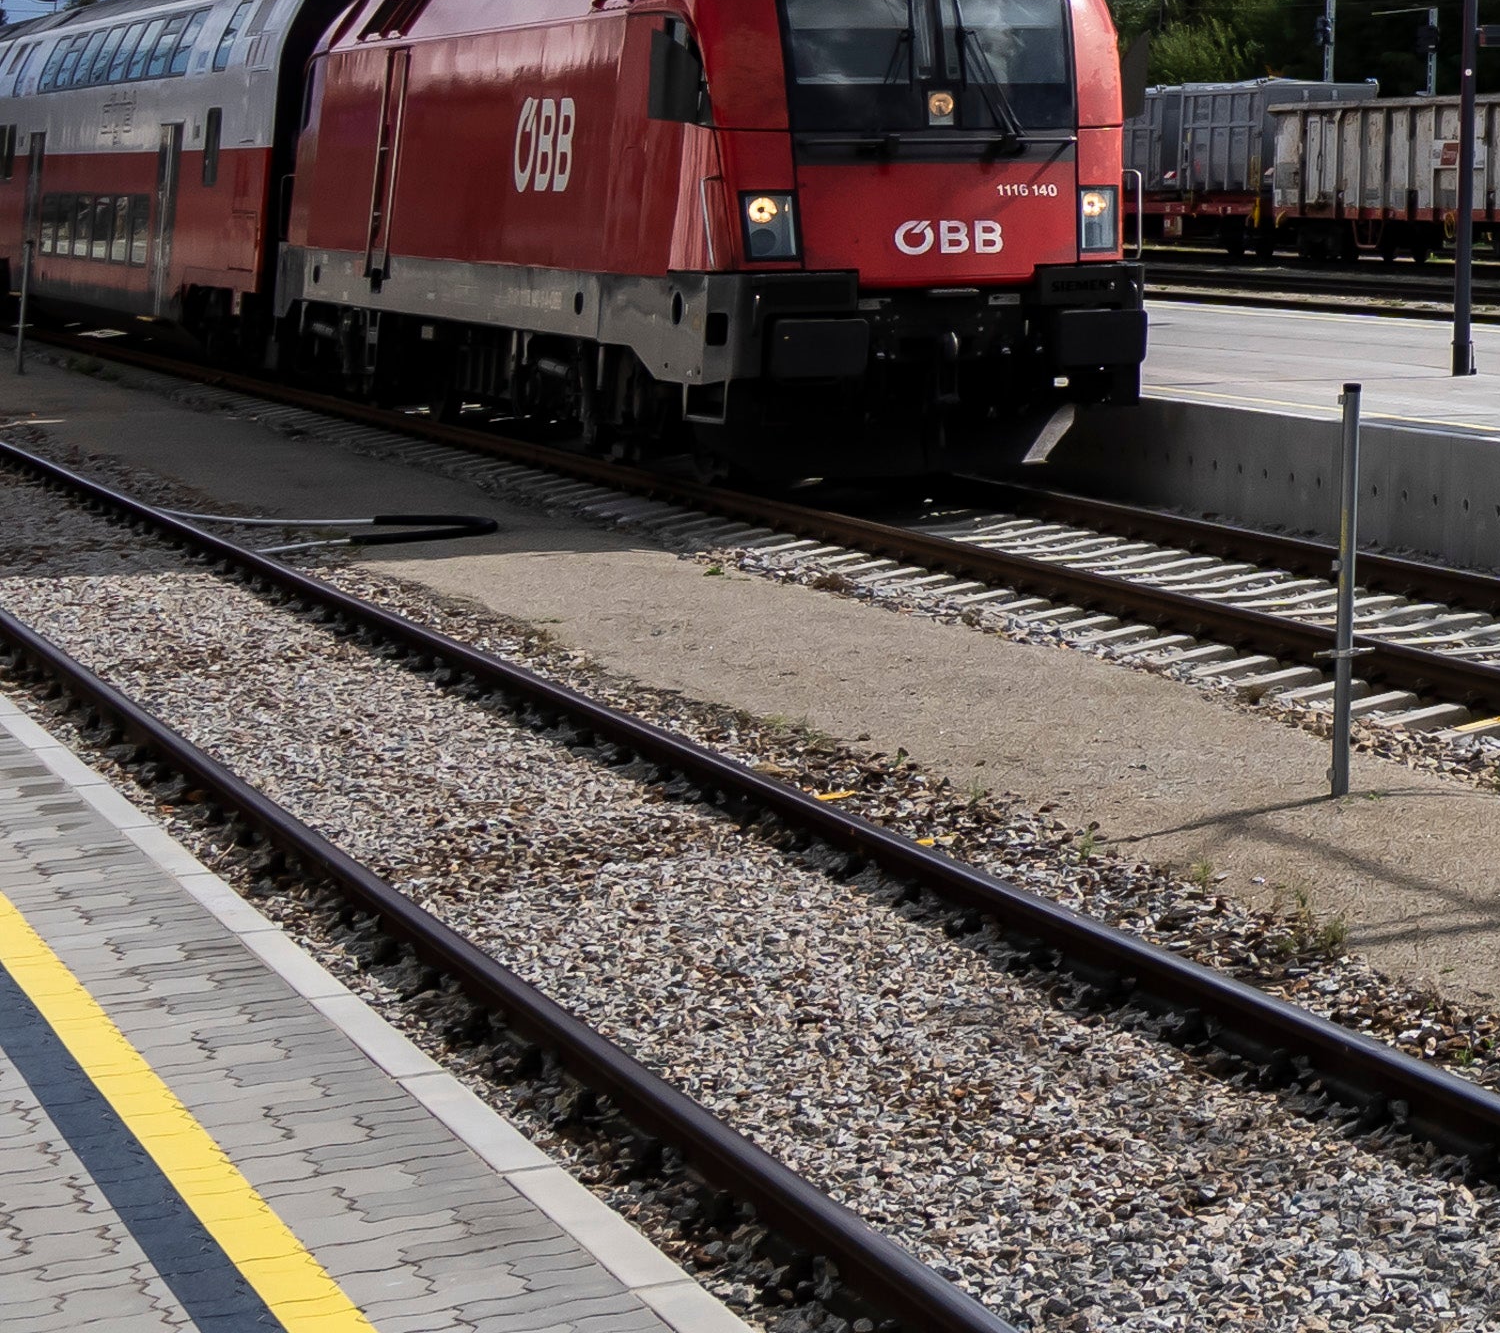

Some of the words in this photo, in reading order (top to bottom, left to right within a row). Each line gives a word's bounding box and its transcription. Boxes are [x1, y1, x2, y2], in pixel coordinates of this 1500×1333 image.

[514, 96, 576, 193] ÖBB
[996, 184, 1029, 197] 1116
[1032, 184, 1058, 198] 140
[894, 220, 1004, 256] ÖBB
